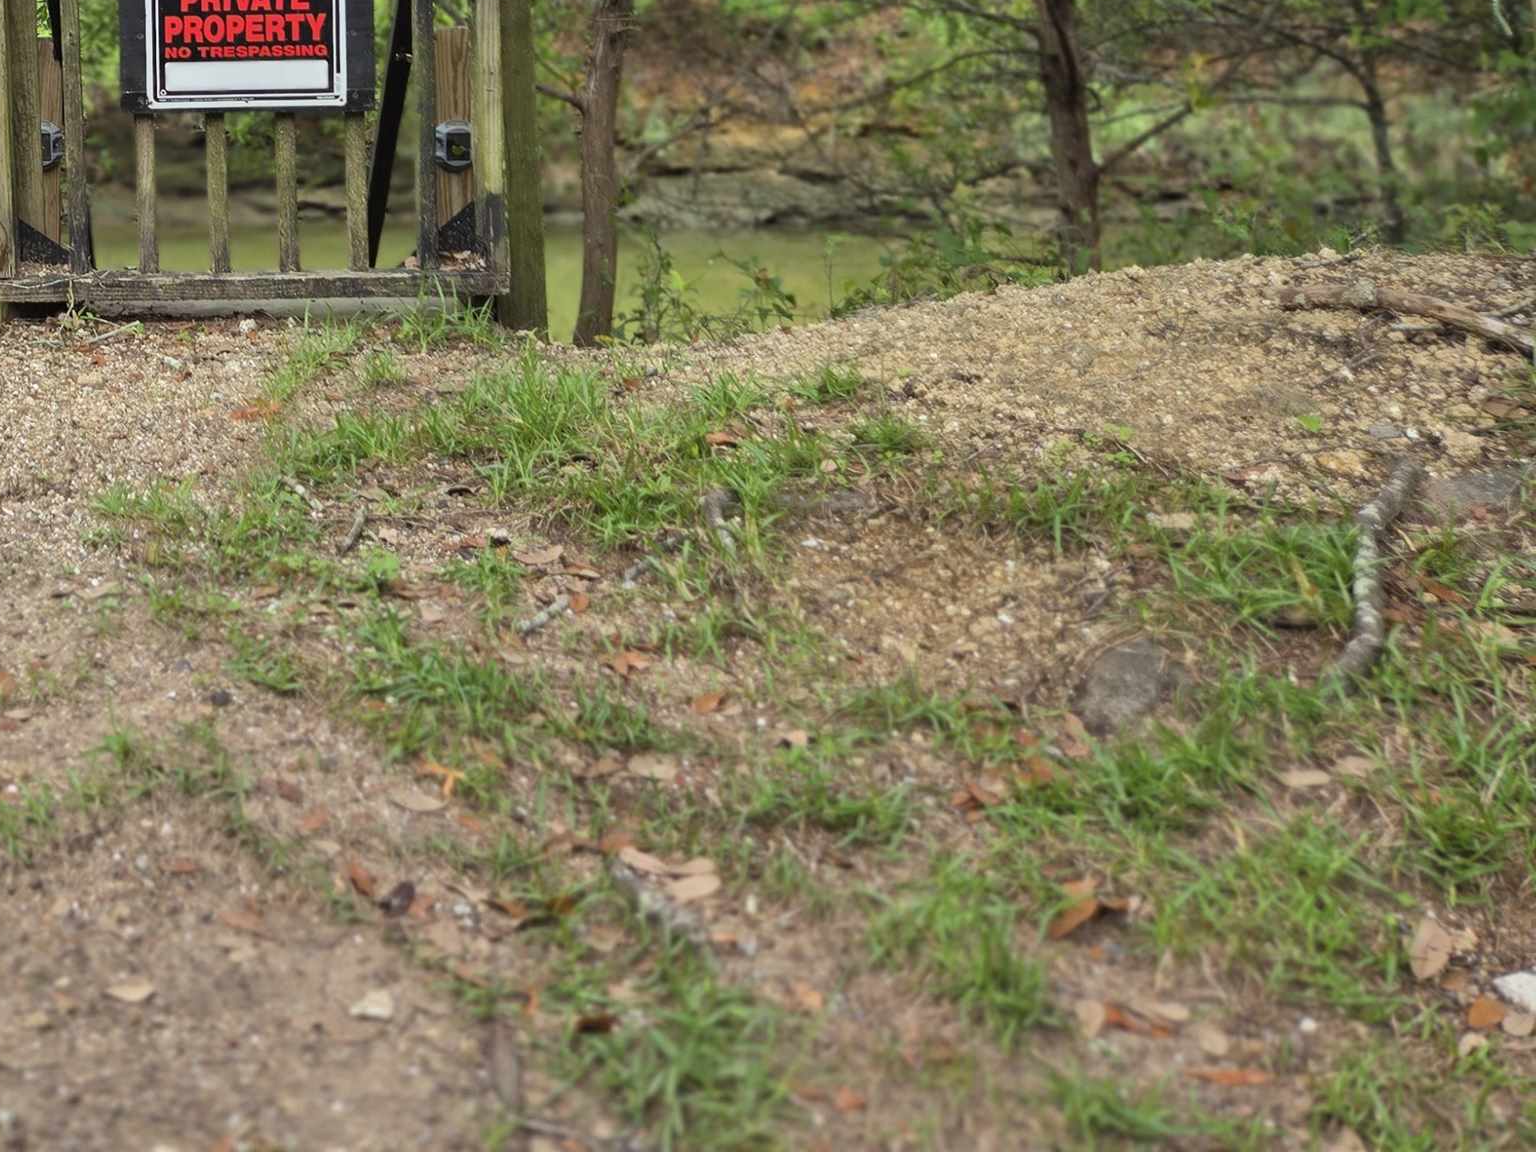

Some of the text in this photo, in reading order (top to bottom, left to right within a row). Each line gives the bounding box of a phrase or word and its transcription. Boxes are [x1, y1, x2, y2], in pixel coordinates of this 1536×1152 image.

[164, 13, 327, 43] PROPERTY
[164, 44, 328, 59] NO TRESPASSING
